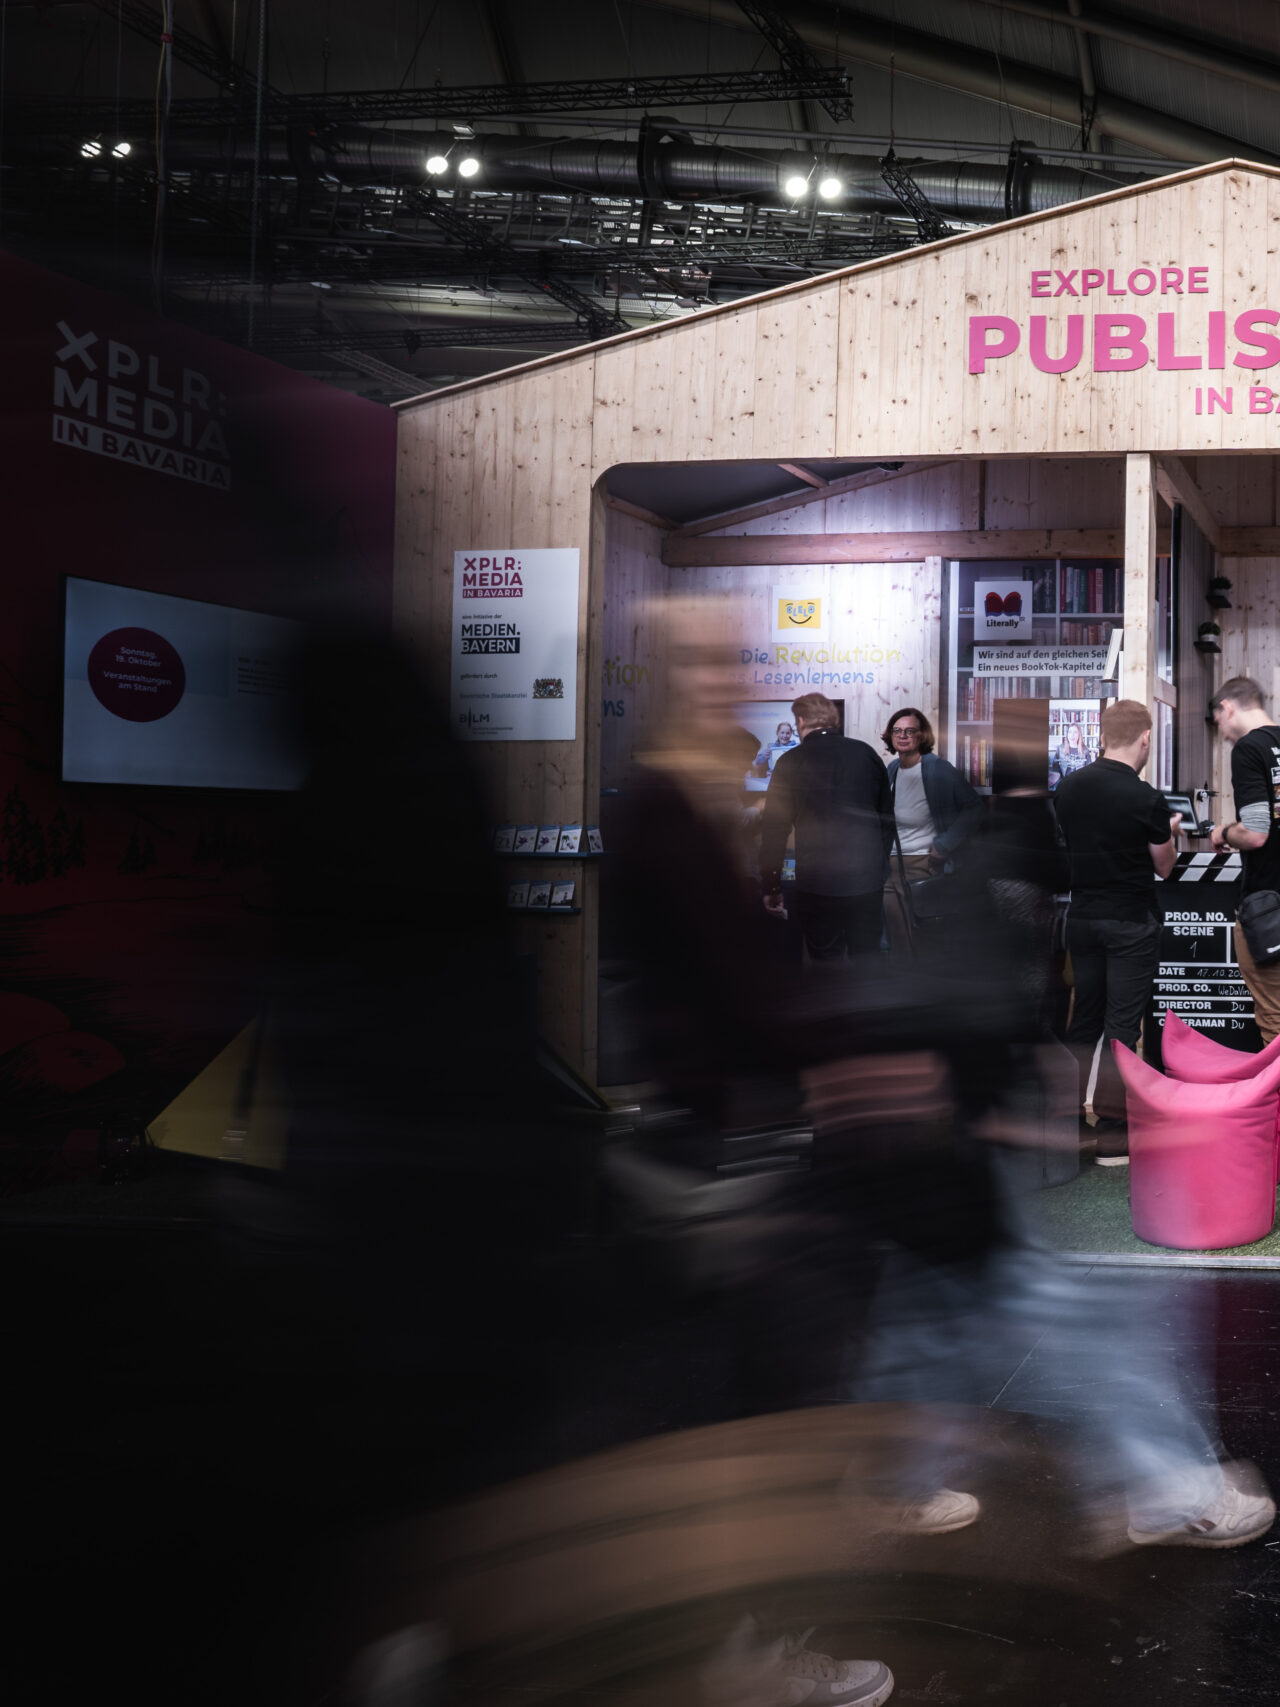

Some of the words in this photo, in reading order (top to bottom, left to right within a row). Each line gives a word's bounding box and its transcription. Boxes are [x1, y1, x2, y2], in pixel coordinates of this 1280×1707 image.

[1030, 267, 1209, 298] EXPLORE
[56, 320, 227, 416] XPLR:
[1195, 387, 1233, 415] IN
[53, 366, 230, 461] MEDIA
[57, 419, 88, 446] IN
[102, 432, 227, 487] BAVARIA
[463, 557, 522, 571] XPLR:
[463, 572, 523, 587] MEDIA
[477, 589, 522, 597] BAVARIA
[461, 623, 520, 636] MEDIEN.
[986, 619, 1019, 629] Literally
[462, 640, 516, 653] BAYERN
[740, 649, 768, 664] Die
[776, 644, 902, 664] Revolution
[978, 651, 994, 659] Wir
[995, 650, 1014, 659] sind
[1016, 650, 1031, 658] auf
[1037, 650, 1050, 658] den
[1052, 650, 1089, 661] gleichen
[128, 656, 161, 667] Oktober
[978, 663, 991, 671] Ein
[1021, 662, 1094, 672] BookTok-Kapitel
[104, 671, 172, 686] Veranstaltungen
[753, 667, 875, 684] Lesenlernens
[133, 683, 158, 693] Stand
[1165, 912, 1202, 921] PROD.
[1206, 912, 1228, 921] NO.
[1173, 926, 1214, 936] SCENE
[1189, 940, 1197, 958] 1
[1159, 967, 1186, 976] DATE
[1159, 984, 1191, 992] PROD.
[1193, 984, 1212, 992] CO.
[1217, 985, 1252, 996] WeDaVin
[1158, 1001, 1211, 1010] DIRECTOR
[1231, 1002, 1245, 1011] Du
[1231, 1019, 1245, 1029] Du
